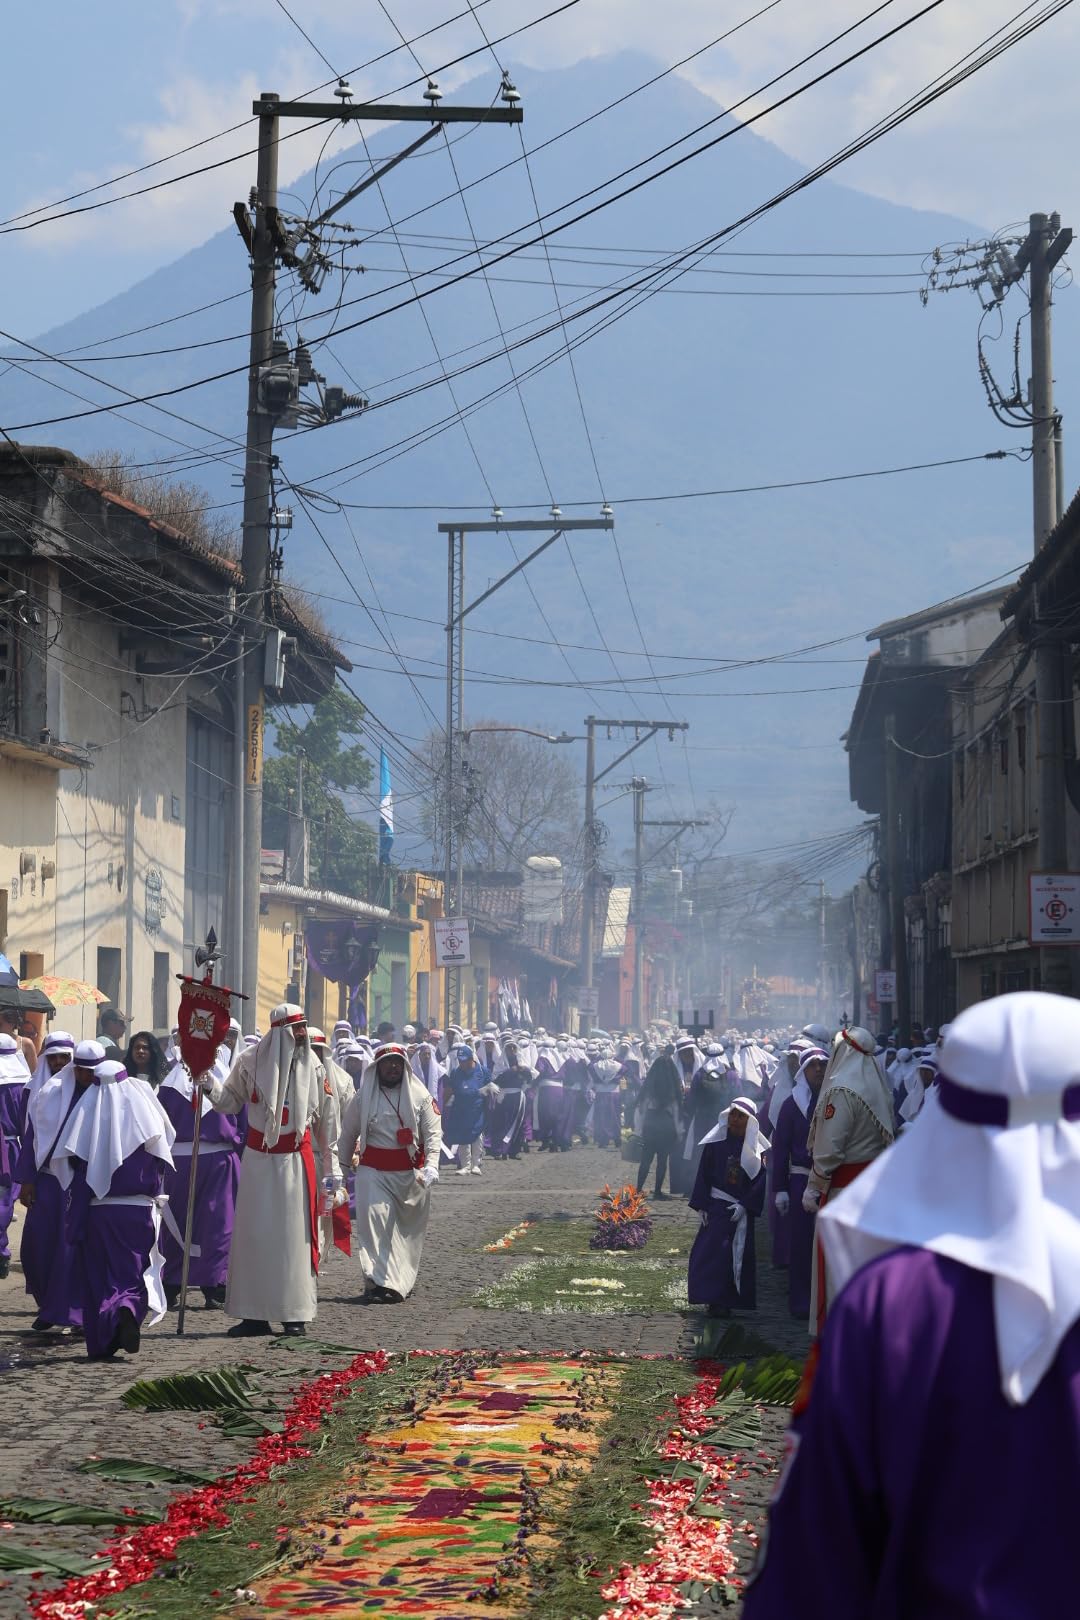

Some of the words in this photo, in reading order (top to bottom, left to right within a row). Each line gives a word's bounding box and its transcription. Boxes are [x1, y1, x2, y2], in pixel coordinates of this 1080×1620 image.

[251, 710, 259, 784] 225814
[1051, 903, 1061, 917] E
[449, 938, 456, 948] E
